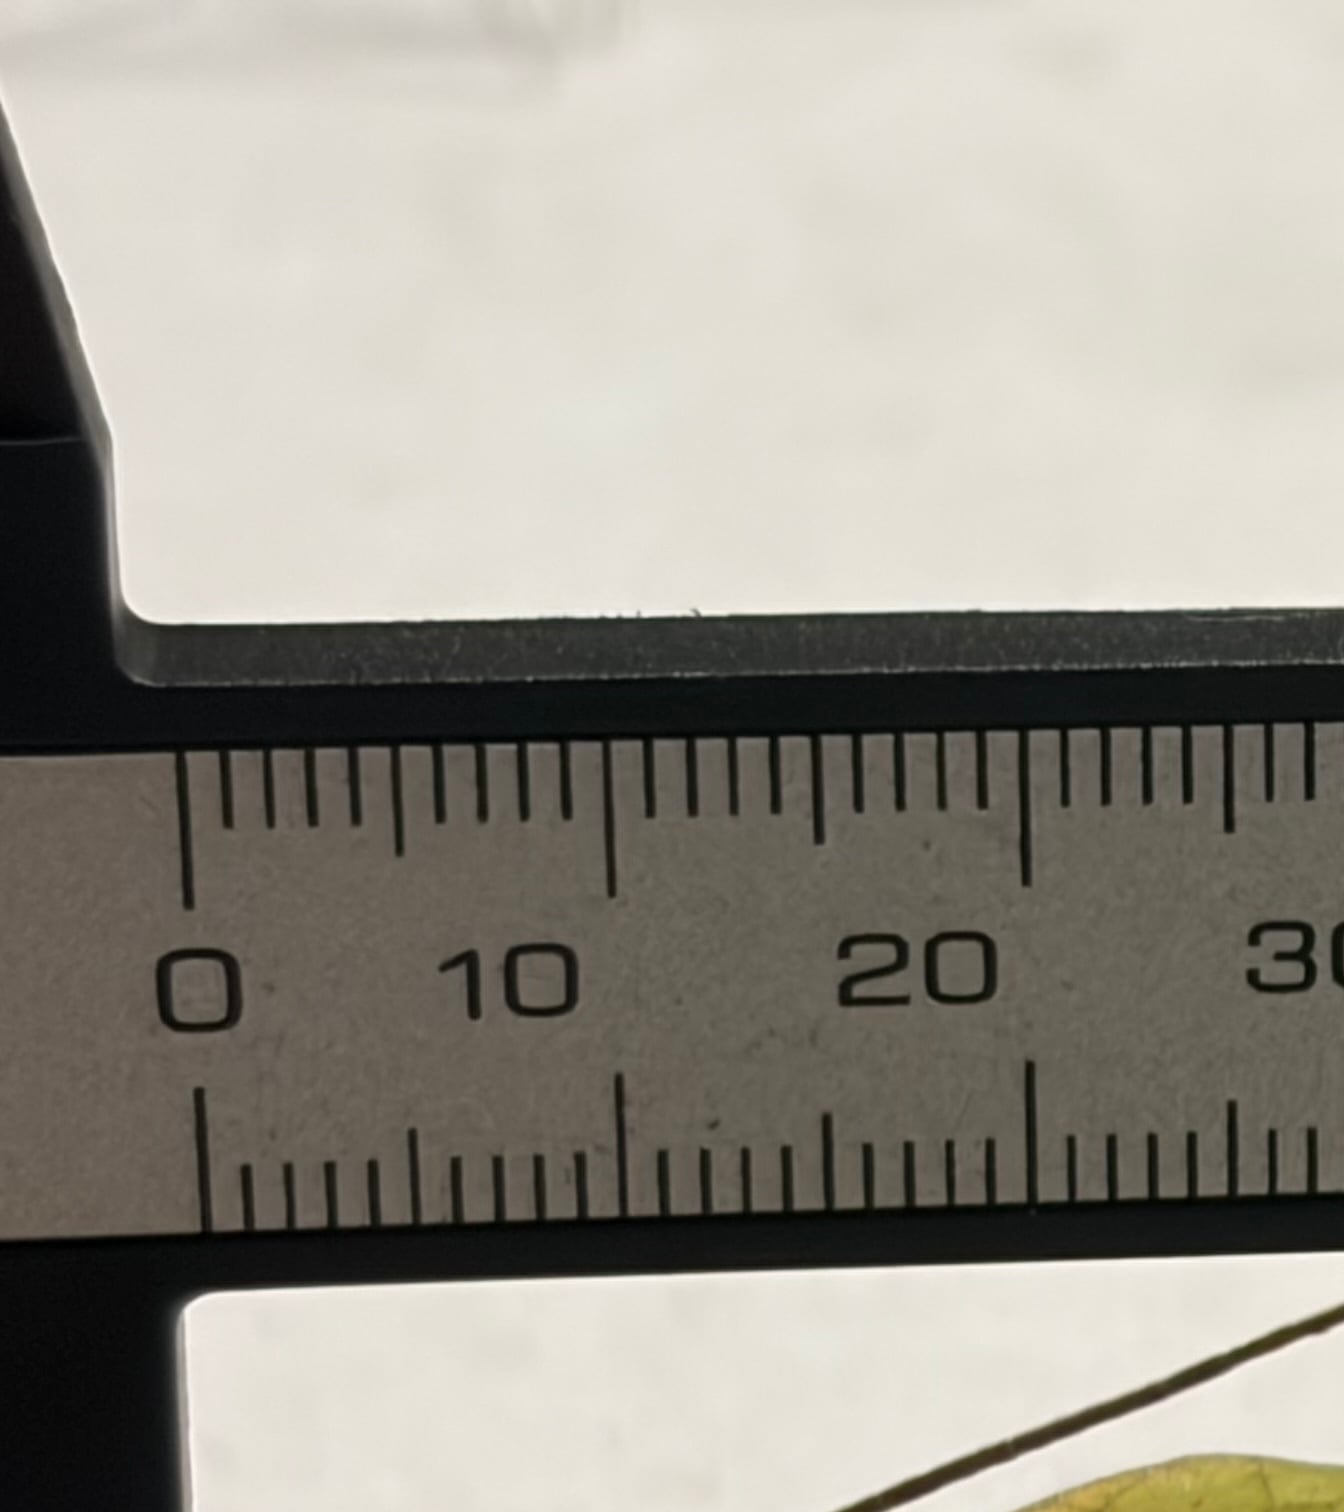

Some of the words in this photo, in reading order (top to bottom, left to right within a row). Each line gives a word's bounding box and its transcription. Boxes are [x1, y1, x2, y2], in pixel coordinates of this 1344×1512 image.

[154, 946, 245, 1034] 0
[438, 940, 579, 1021] 10
[837, 931, 999, 1007] 20
